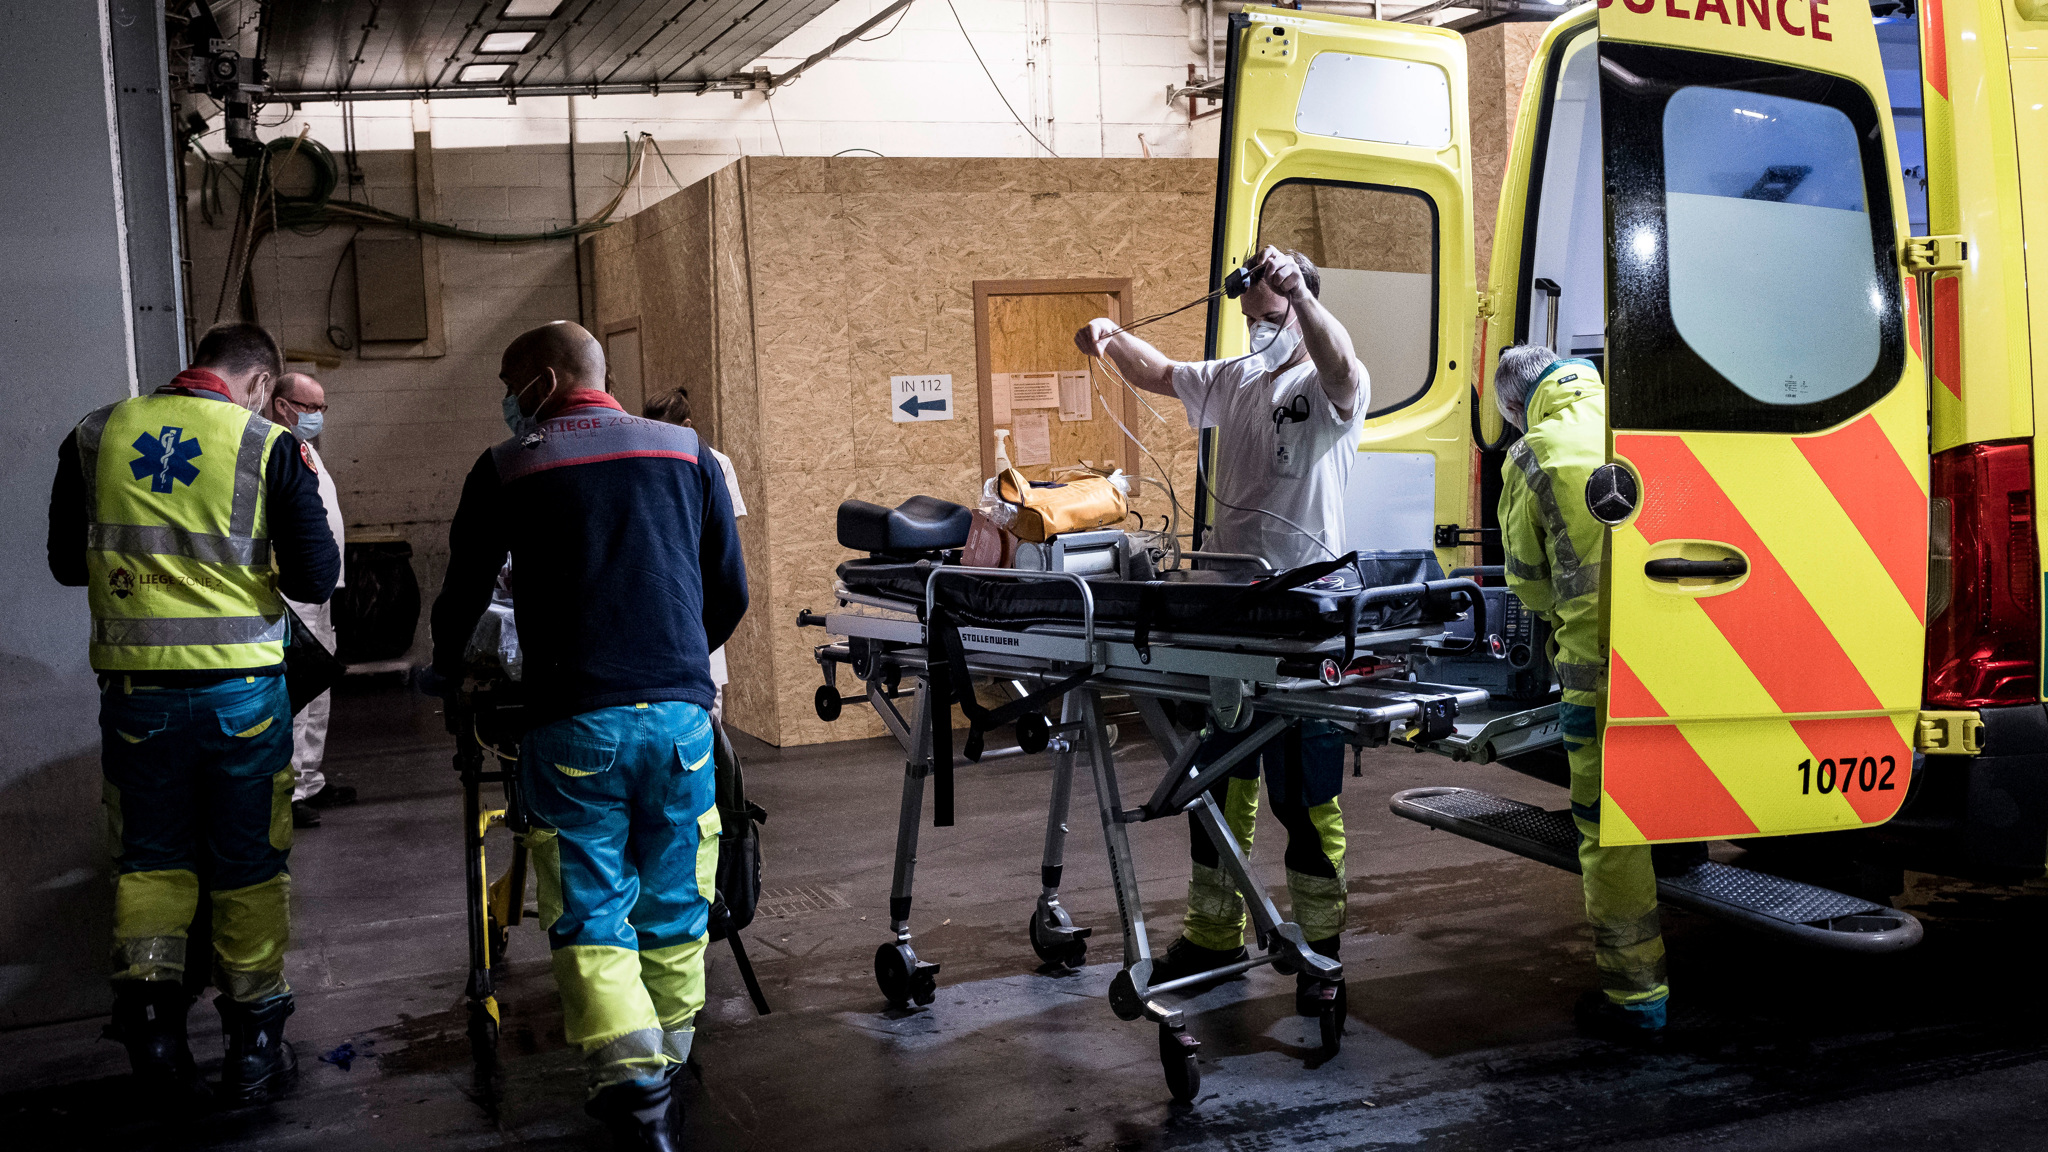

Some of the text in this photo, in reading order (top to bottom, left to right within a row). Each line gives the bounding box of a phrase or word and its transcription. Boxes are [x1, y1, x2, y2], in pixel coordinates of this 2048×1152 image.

[1598, 0, 1833, 42] LANCE
[901, 379, 942, 393] IN 112
[549, 418, 602, 433] LIEGE
[139, 574, 223, 587] LIEGE ZONE 2
[961, 633, 1019, 646] STOLLENWERK
[1798, 755, 1896, 795] 10702
